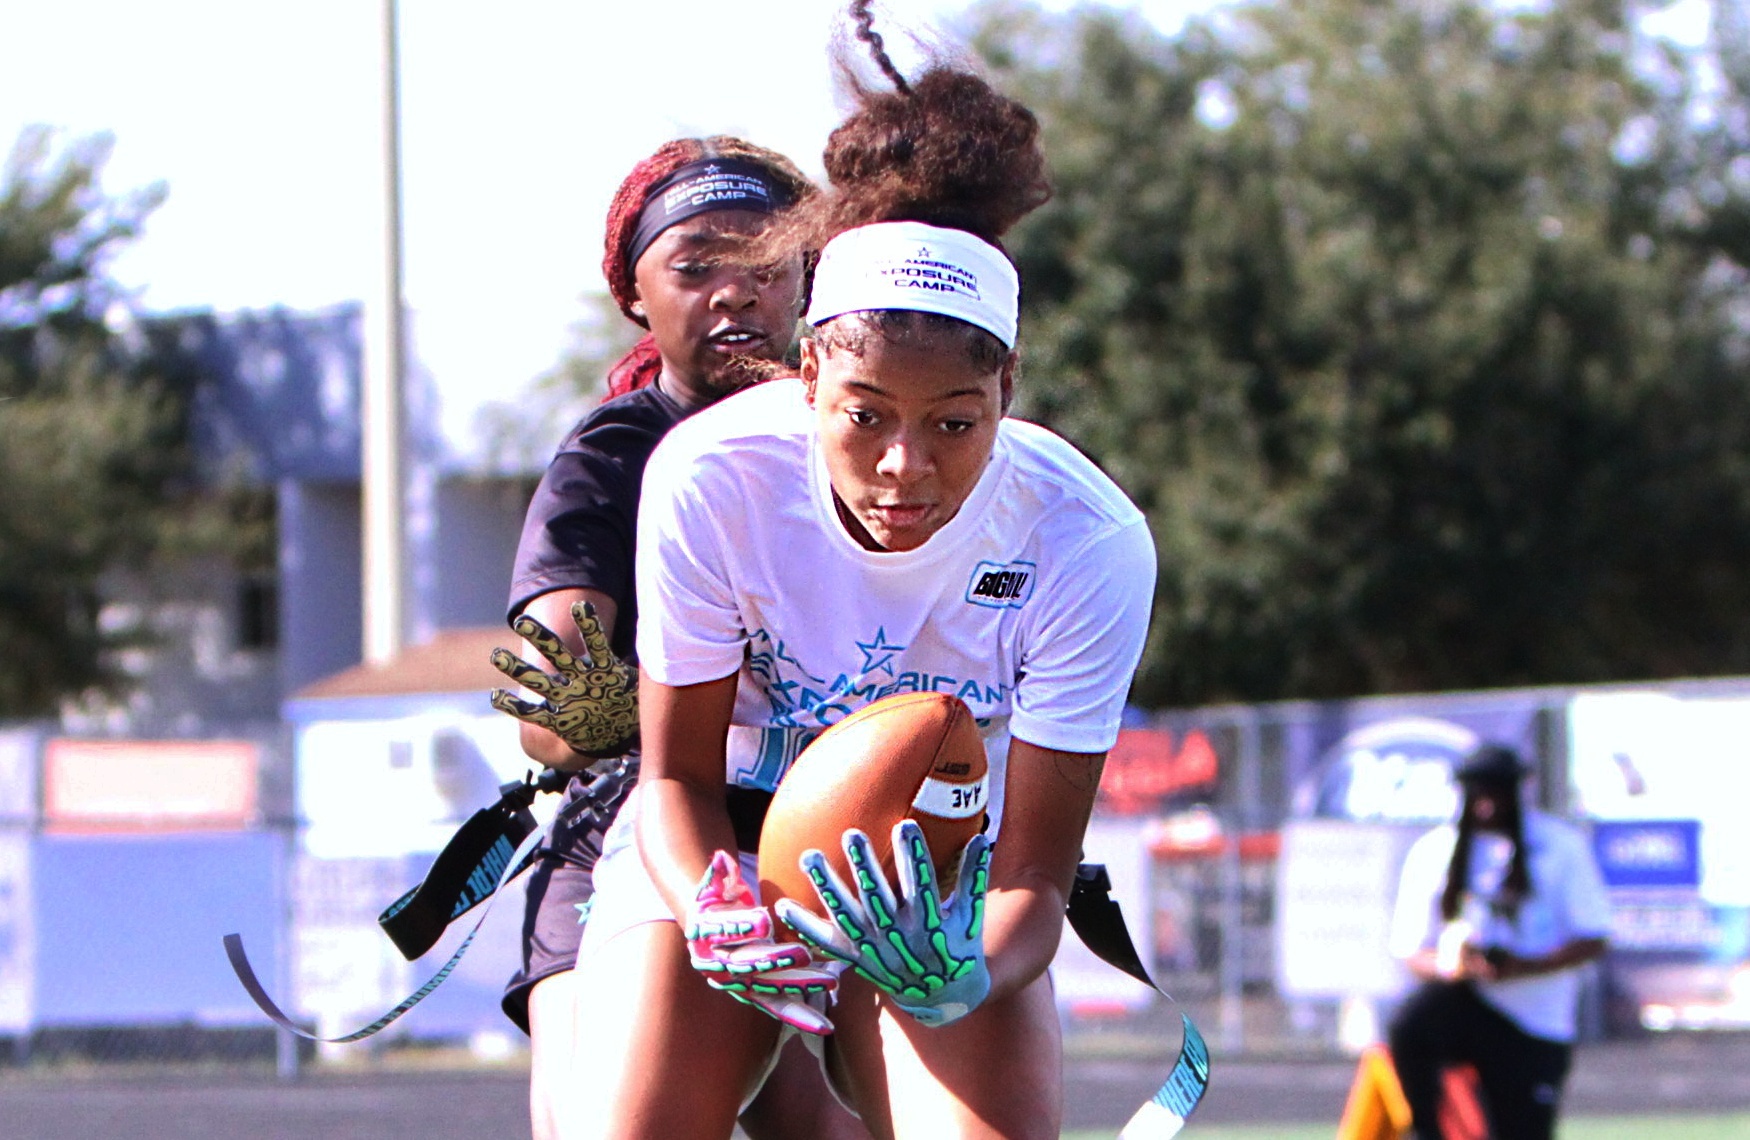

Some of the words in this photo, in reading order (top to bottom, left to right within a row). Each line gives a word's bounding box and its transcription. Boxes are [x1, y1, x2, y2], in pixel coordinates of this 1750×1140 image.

[691, 191, 747, 206] CAMP
[894, 279, 956, 292] CAMP
[952, 784, 982, 809] AAE
